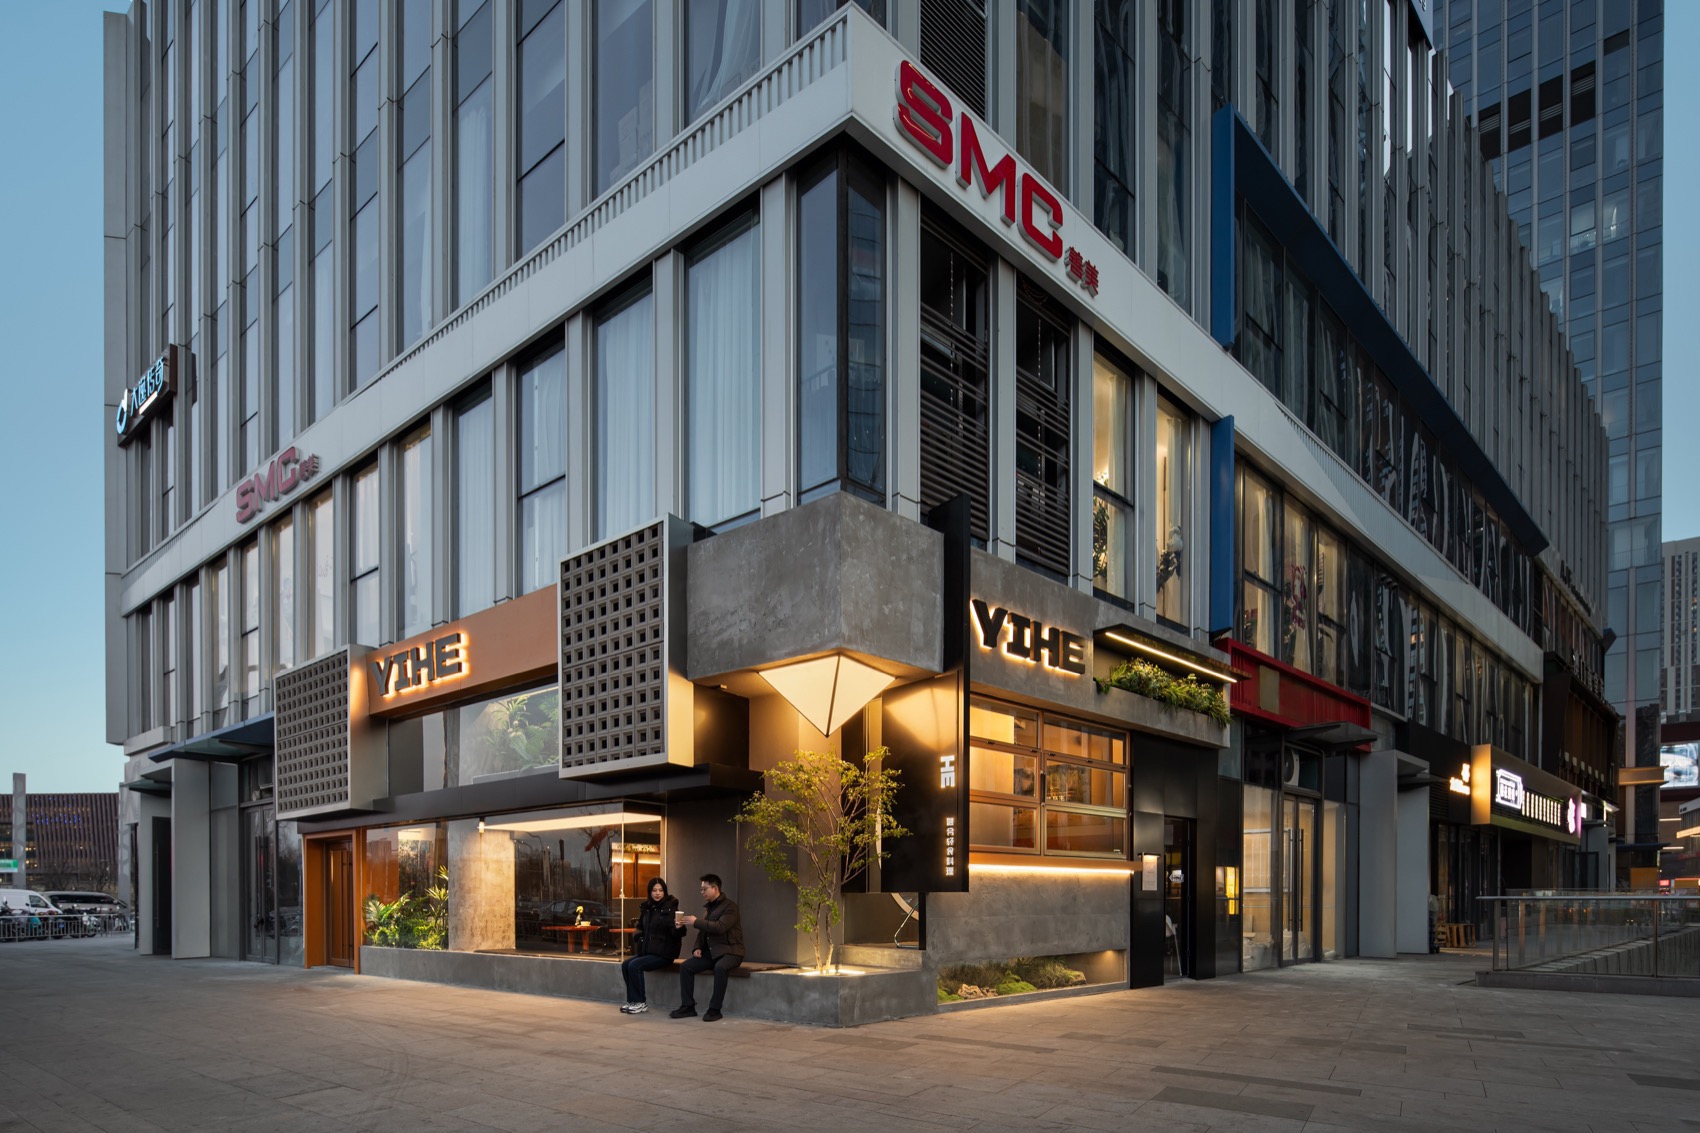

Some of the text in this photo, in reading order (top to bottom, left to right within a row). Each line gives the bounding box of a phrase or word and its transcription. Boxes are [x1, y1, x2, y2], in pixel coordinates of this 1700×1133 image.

[895, 60, 1099, 296] SMC 善美
[236, 447, 300, 523] SMC
[370, 632, 464, 697] YIHE
[971, 599, 1086, 676] YIHE
